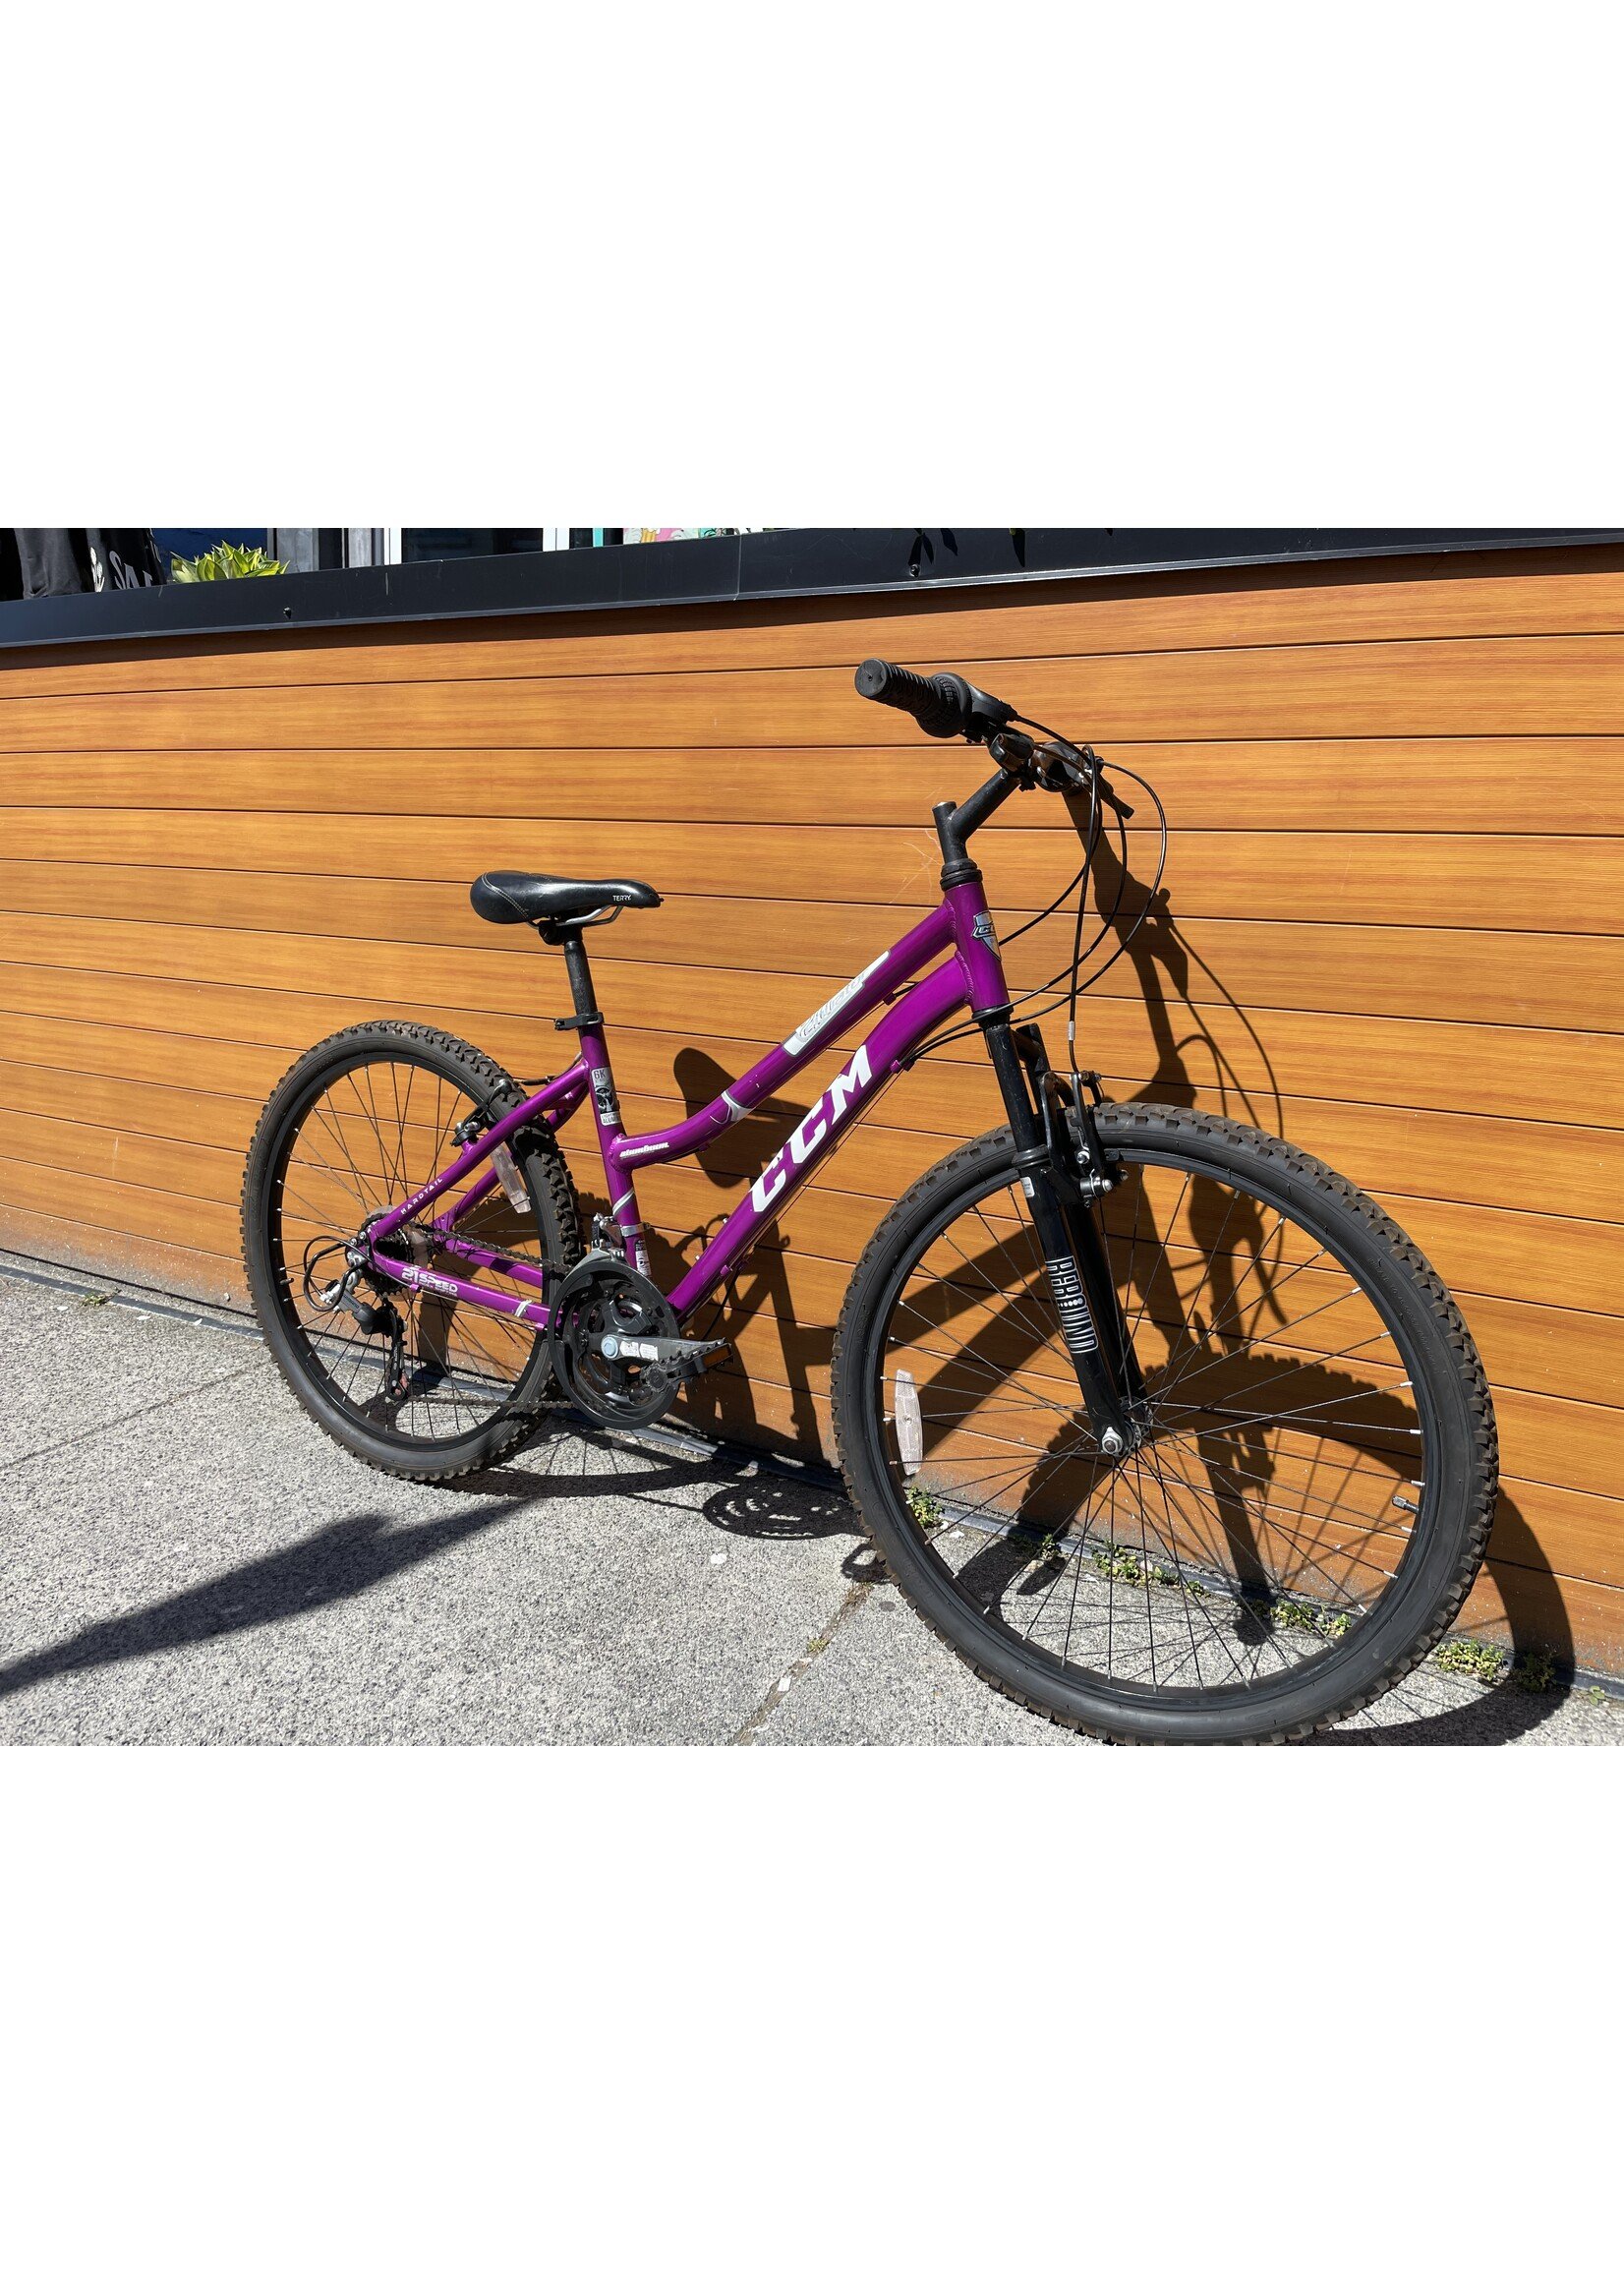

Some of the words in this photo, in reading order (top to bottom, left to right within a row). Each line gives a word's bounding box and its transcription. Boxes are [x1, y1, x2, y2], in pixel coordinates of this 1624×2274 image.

[748, 1044, 873, 1212] CCM
[400, 1177, 443, 1215] HARDTAIL
[1045, 1255, 1099, 1354] REBOUND
